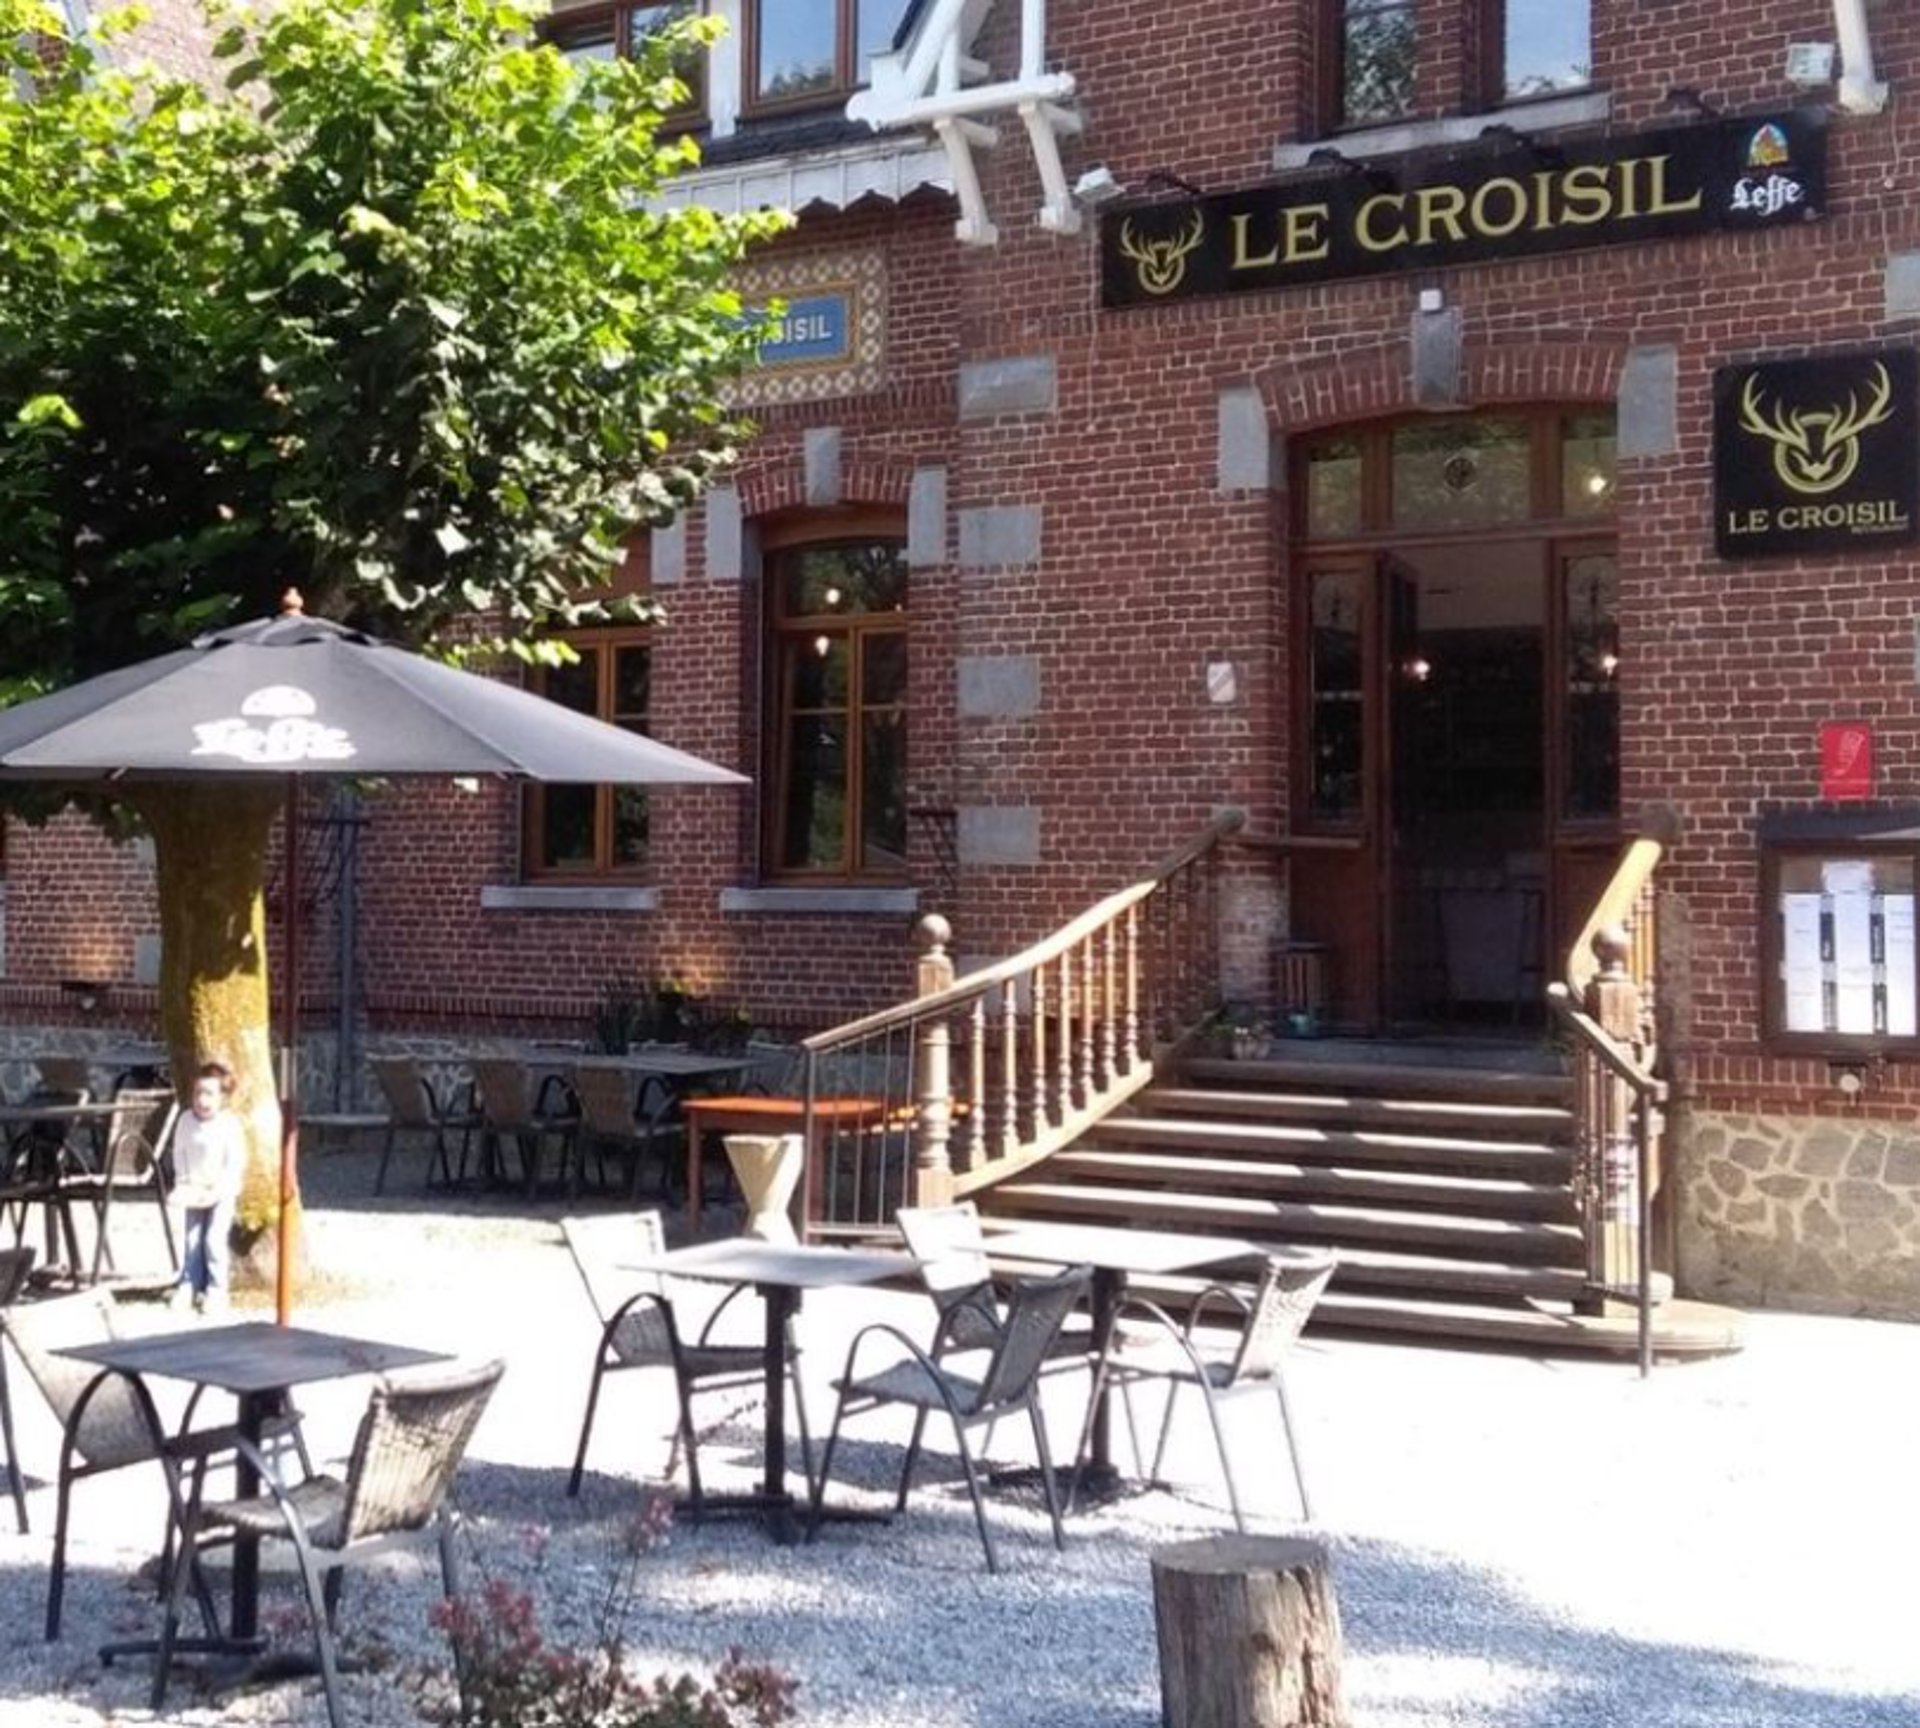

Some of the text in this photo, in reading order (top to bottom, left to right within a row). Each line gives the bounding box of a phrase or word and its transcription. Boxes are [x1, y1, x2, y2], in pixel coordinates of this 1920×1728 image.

[1231, 155, 1703, 270] LE CROISIL
[1730, 174, 1805, 217] Leffe
[1729, 509, 1769, 534] LE
[1777, 500, 1909, 530] CROISIL
